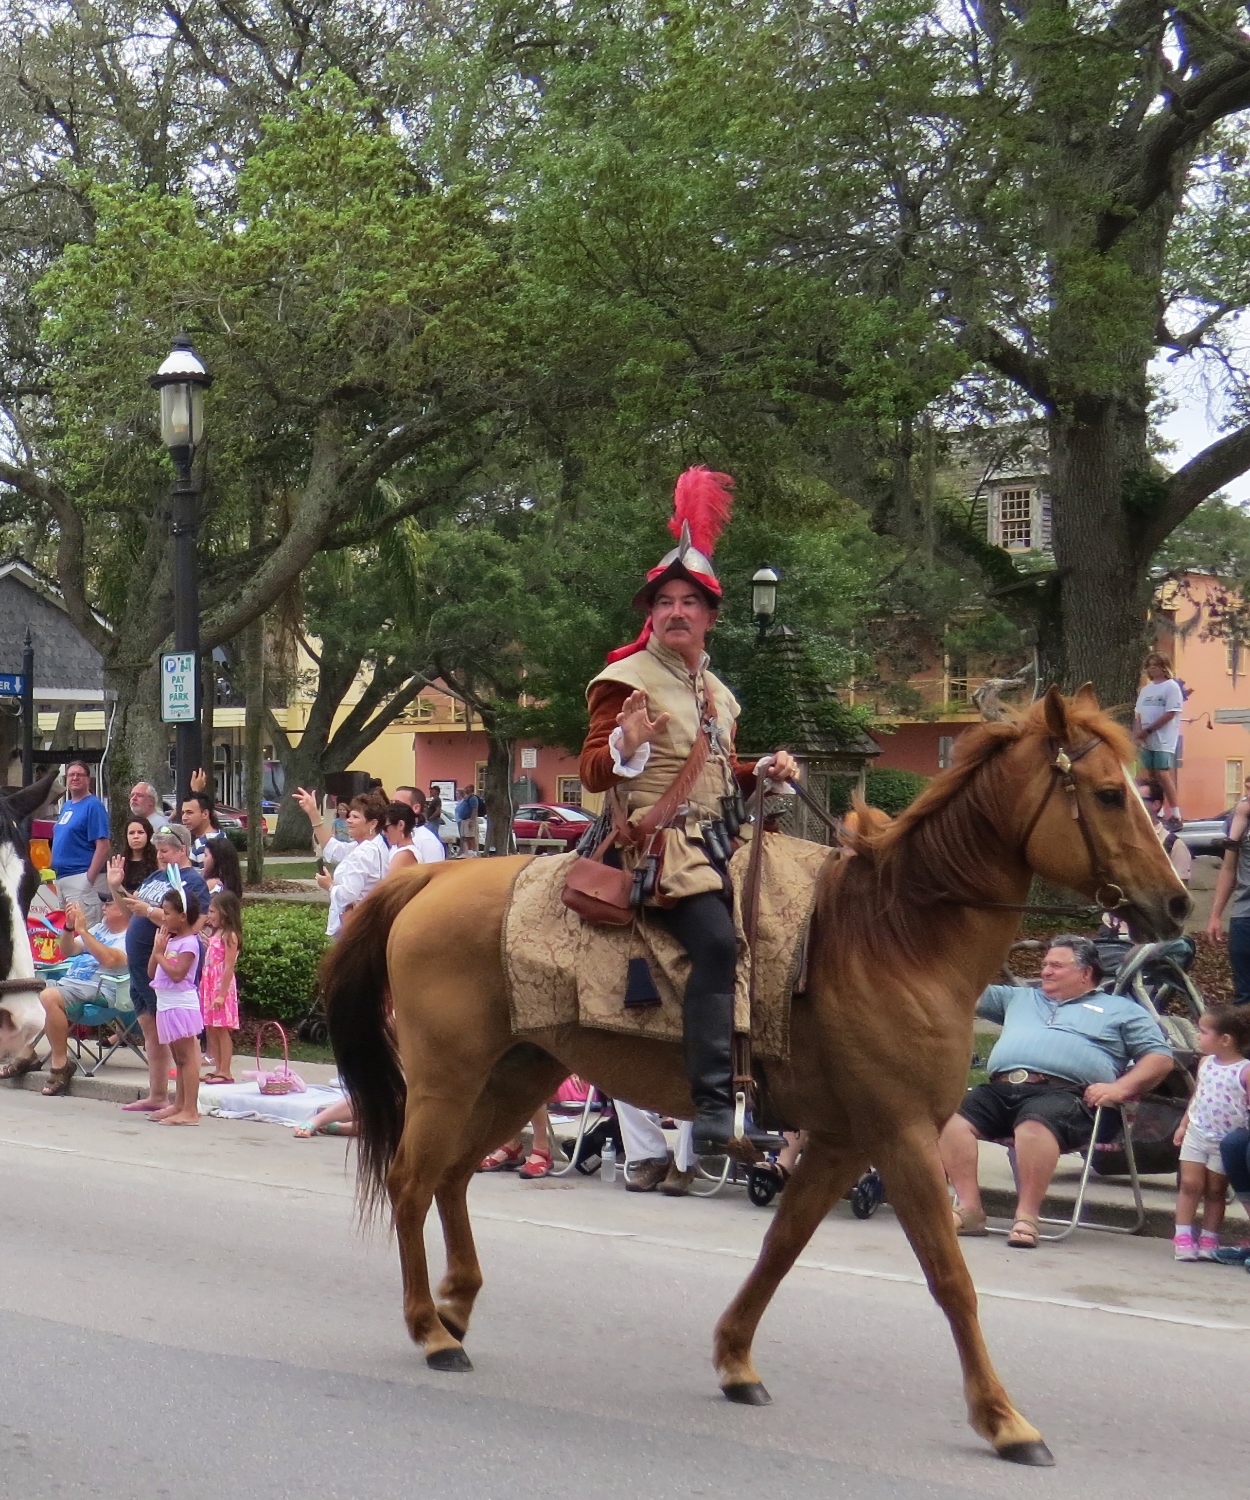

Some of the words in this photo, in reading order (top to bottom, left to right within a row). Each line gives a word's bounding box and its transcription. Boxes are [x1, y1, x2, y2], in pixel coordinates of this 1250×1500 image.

[171, 675, 186, 684] PAY
[173, 684, 184, 692] TO
[169, 692, 189, 701] PARK
